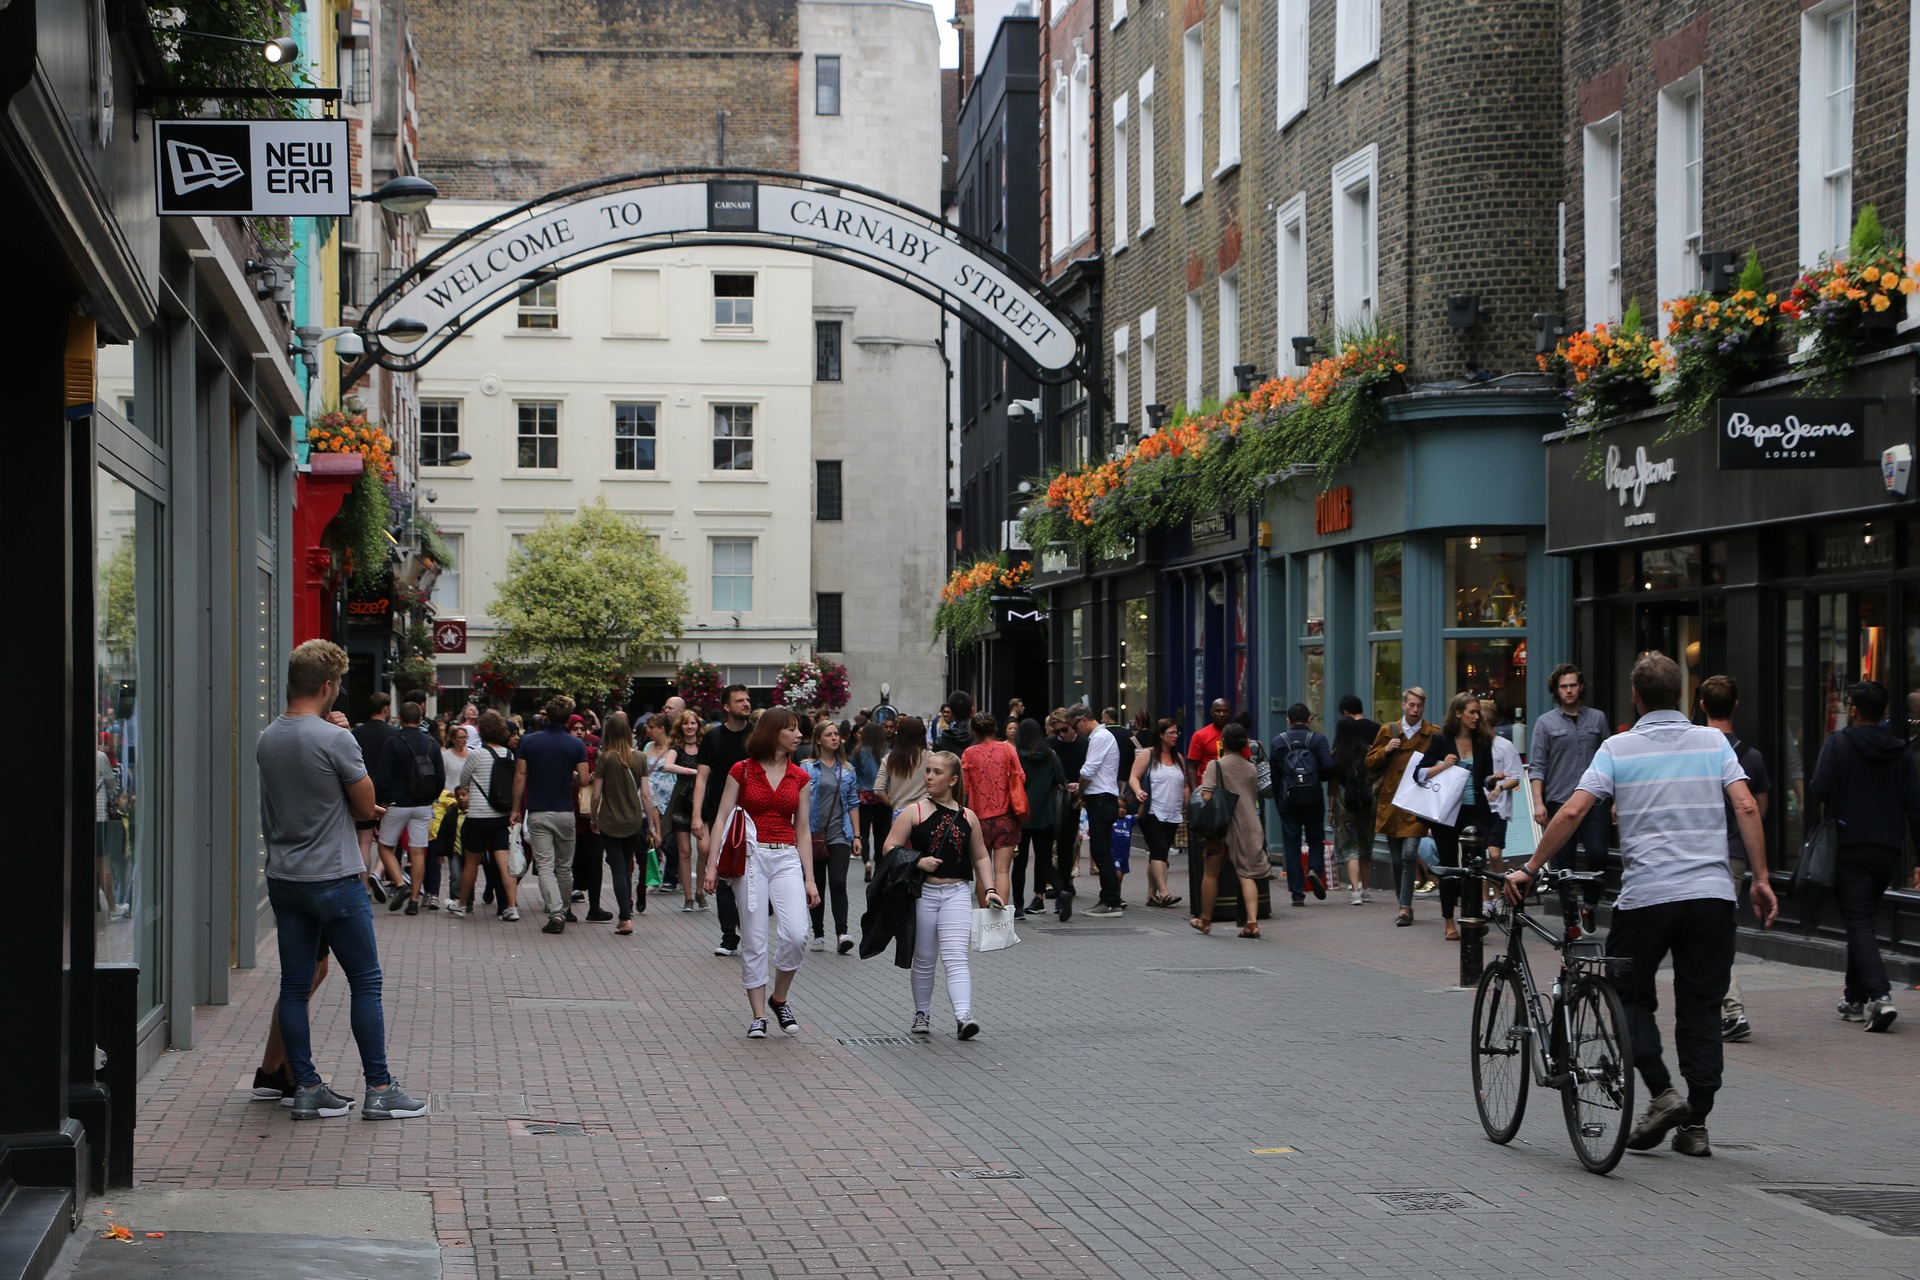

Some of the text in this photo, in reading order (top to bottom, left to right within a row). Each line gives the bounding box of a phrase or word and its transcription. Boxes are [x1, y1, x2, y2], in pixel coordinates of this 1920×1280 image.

[266, 142, 332, 167] NEW
[267, 169, 333, 194] ERA
[714, 200, 752, 210] CARNABY
[424, 202, 642, 309] WELCOME TO
[790, 200, 1057, 347] CARNABY STREET
[1727, 412, 1854, 449] Pepe Jeans
[1765, 451, 1816, 459] LONDON
[1605, 445, 1677, 508] Pepe Jeans
[348, 598, 389, 614] size?
